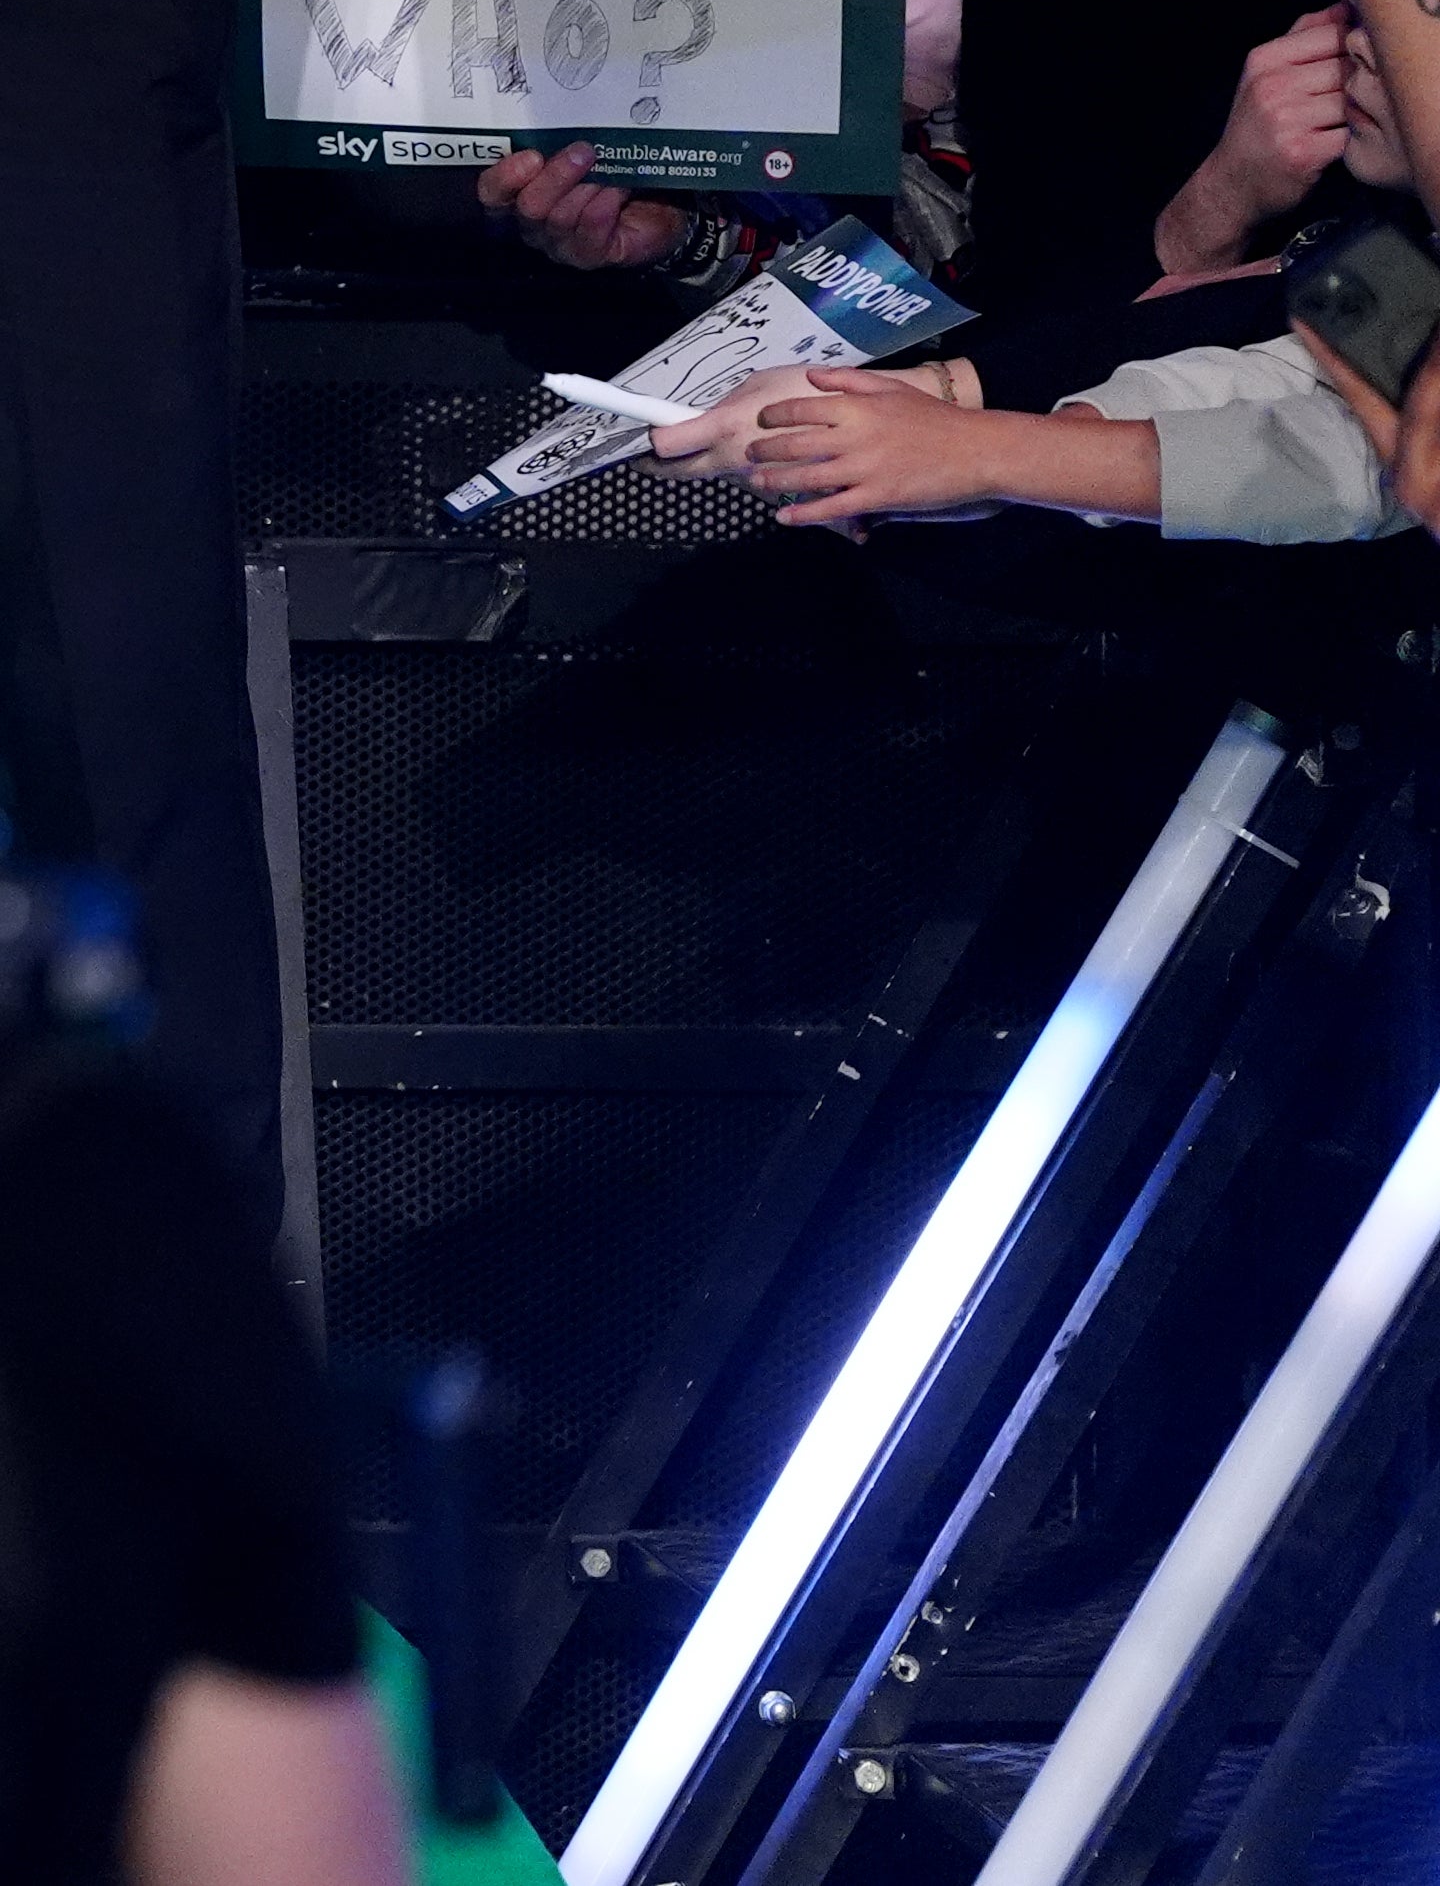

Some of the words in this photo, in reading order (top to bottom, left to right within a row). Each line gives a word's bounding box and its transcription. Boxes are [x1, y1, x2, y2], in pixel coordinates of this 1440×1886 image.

[316, 131, 377, 162] sky
[390, 137, 507, 162] sports
[593, 143, 743, 165] GambleAware.org
[787, 245, 933, 326] PADDYPOWER
